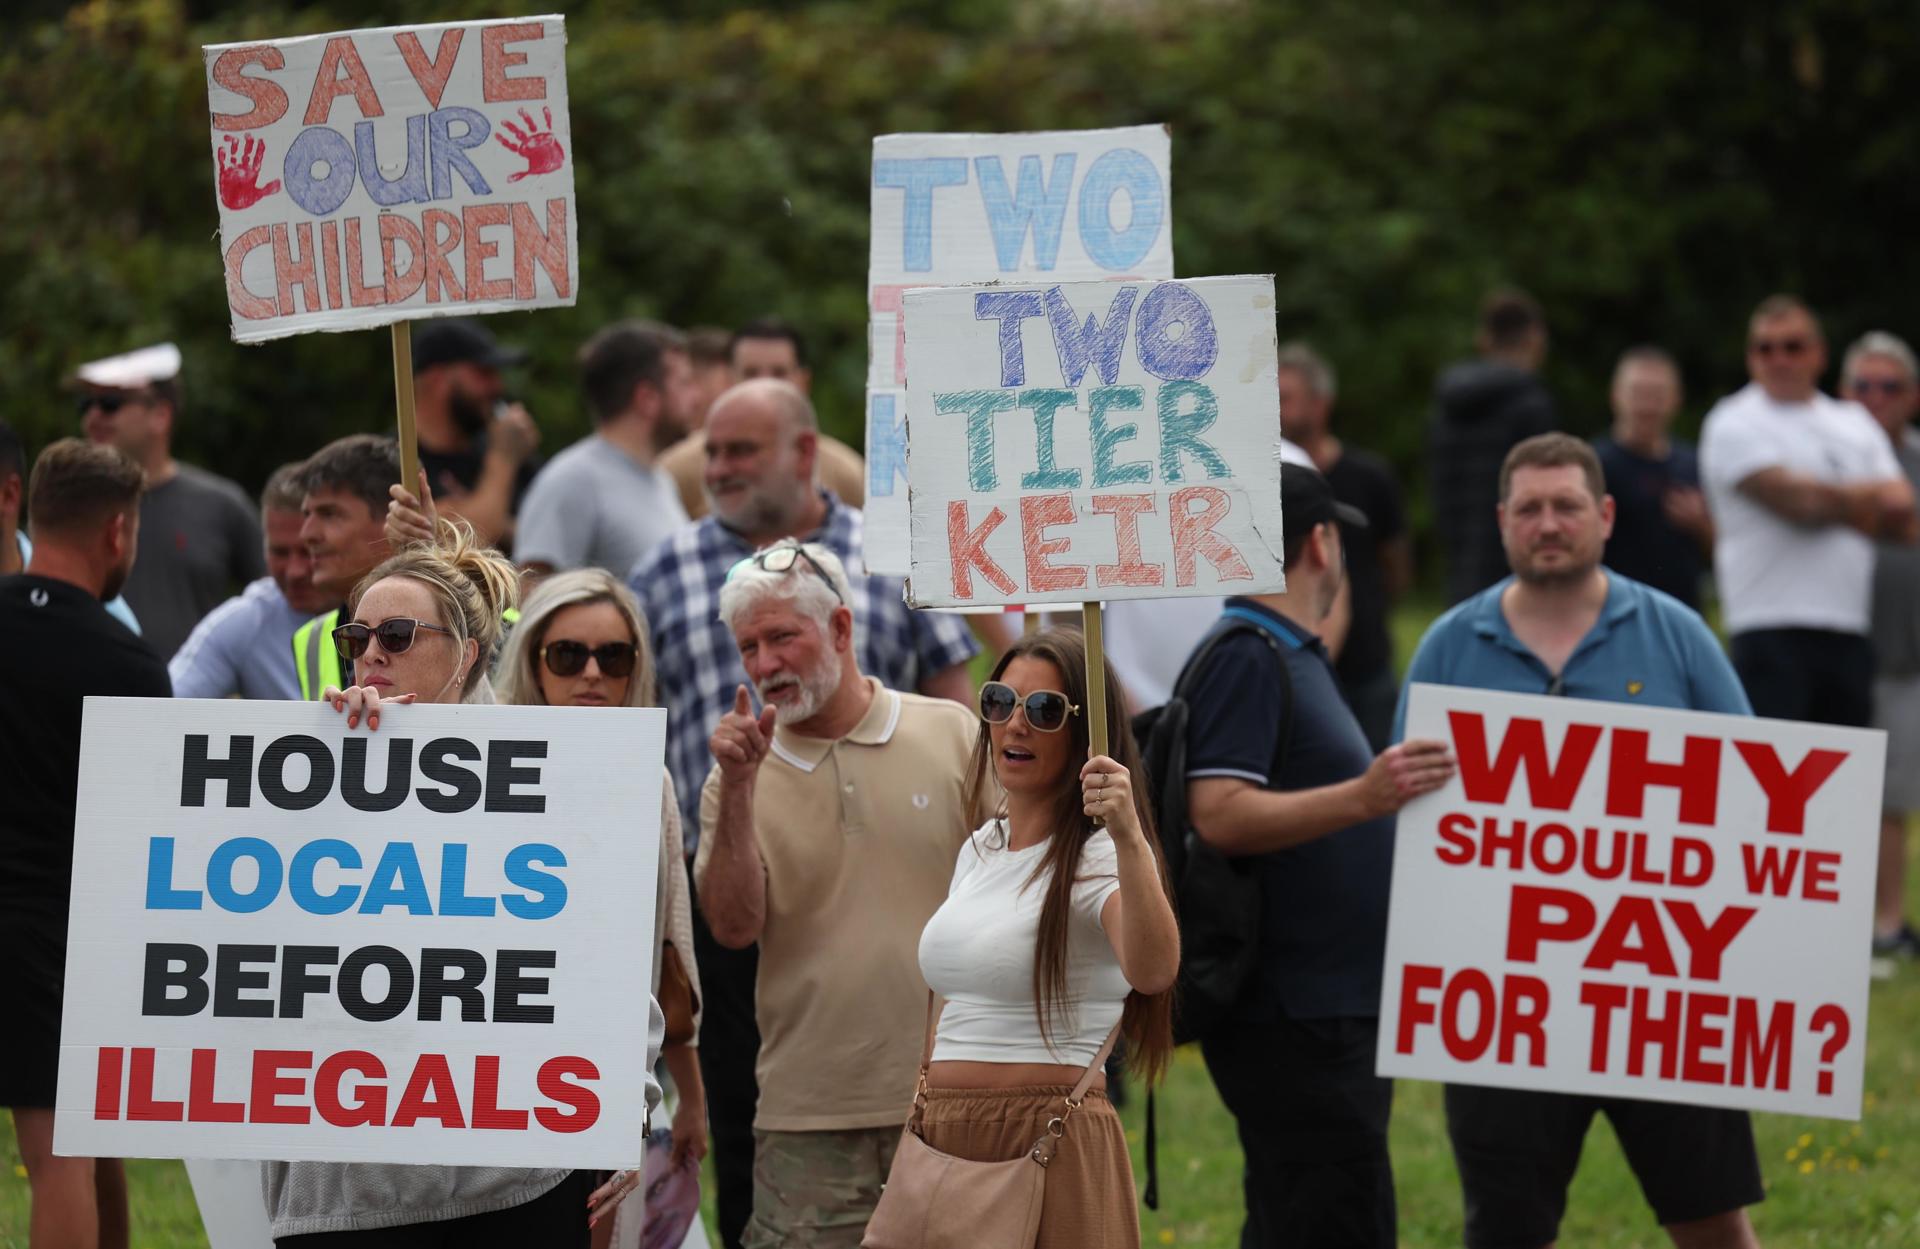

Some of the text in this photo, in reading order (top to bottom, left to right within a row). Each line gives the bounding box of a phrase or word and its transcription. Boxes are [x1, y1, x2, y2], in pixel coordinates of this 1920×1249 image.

[212, 22, 547, 131] SAVE
[283, 106, 492, 216] OUR
[874, 147, 1164, 273] TWO
[225, 198, 571, 320] CHILDREN
[974, 283, 1218, 388] TWO
[934, 381, 1232, 492] TIER
[948, 486, 1254, 599] KEIR
[180, 734, 548, 813] HOUSE
[1447, 710, 1850, 835] WHY
[145, 836, 568, 920] LOCALS
[1435, 813, 1843, 903] SHOULD WE
[141, 942, 557, 1024] BEFORE
[1506, 884, 1758, 981] PAY
[1395, 964, 1851, 1096] FOR THEM?
[94, 1046, 601, 1133] ILLEGALS
